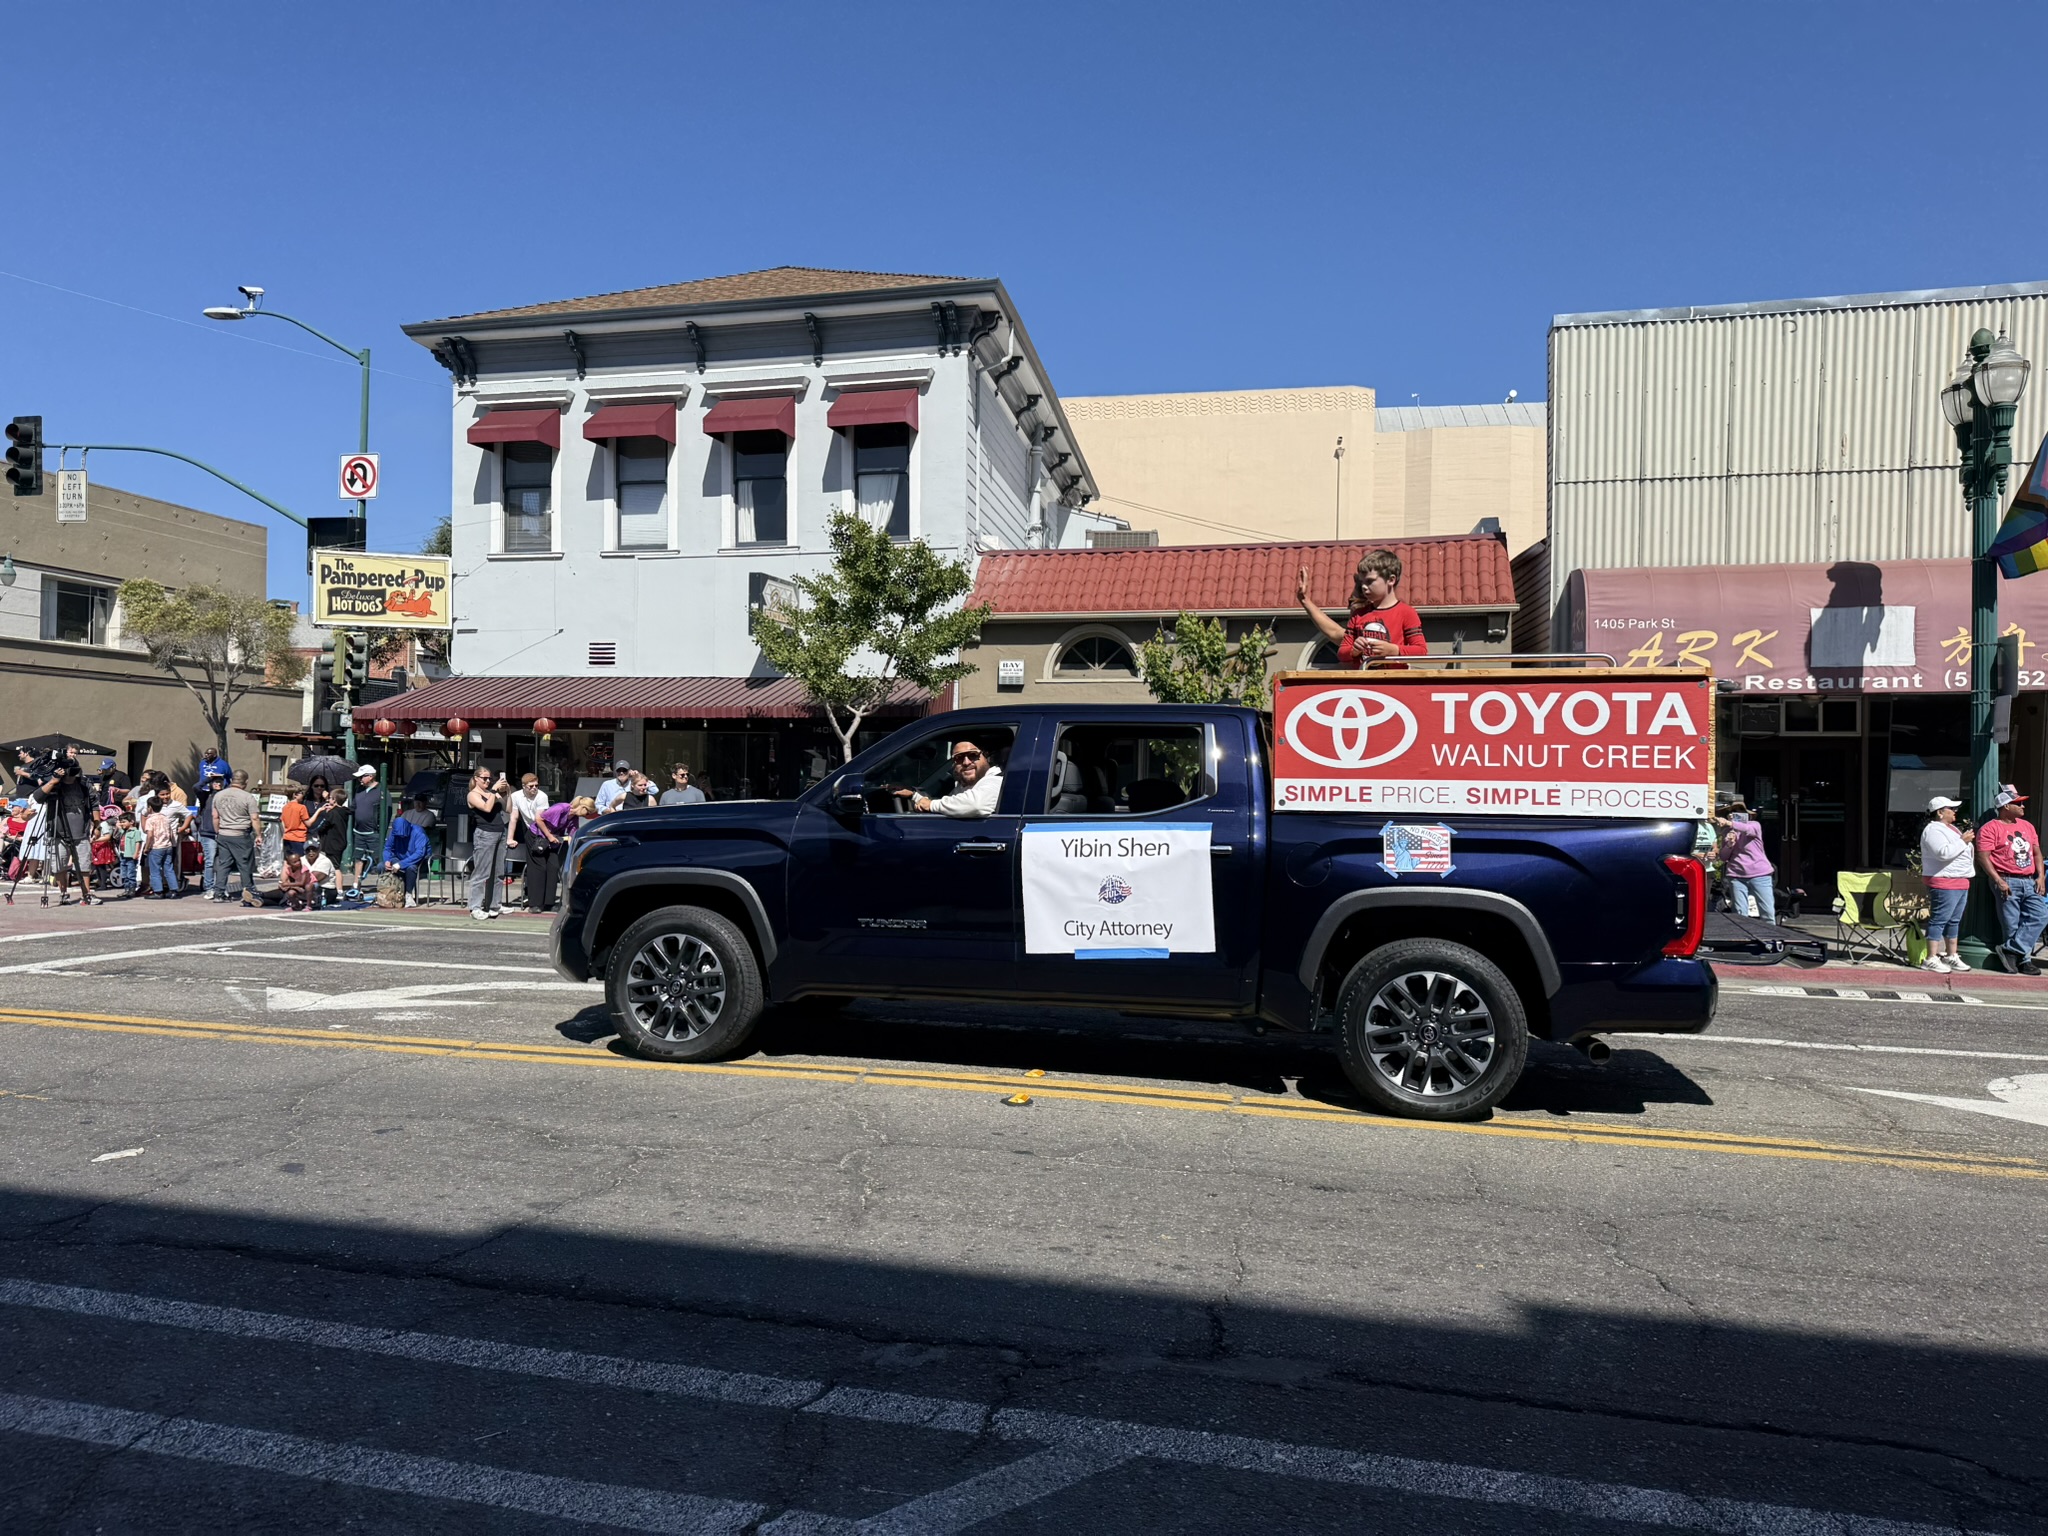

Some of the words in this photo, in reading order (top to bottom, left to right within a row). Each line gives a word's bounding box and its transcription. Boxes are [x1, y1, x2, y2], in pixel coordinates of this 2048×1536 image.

[62, 483, 82, 491] LEFT
[62, 493, 83, 501] TURN
[334, 558, 354, 571] The
[320, 563, 406, 588] Pampered
[414, 568, 446, 592] Pup
[341, 589, 376, 600] Deluxe
[331, 595, 355, 612] HOT
[355, 597, 383, 612] DOGS
[1594, 618, 1625, 629] 1405
[1628, 618, 1658, 629] Park
[1661, 618, 1675, 629] St
[1621, 629, 1779, 668] ARK
[1745, 673, 1923, 690] Restaurant
[1431, 690, 1698, 736] TOYOTA
[1431, 743, 1571, 768] WALNUT
[1582, 744, 1696, 770] CREEK
[1284, 785, 1373, 803] SIMPLE
[1381, 786, 1456, 804] PRICE.
[1466, 787, 1561, 806] SIMPLE
[1571, 788, 1696, 809] PROCESS.
[1409, 826, 1420, 834] NO
[1420, 829, 1443, 844] KINGS
[1061, 838, 1112, 858] Yibin
[1117, 837, 1170, 858] Shen
[1424, 851, 1443, 859] Since
[1425, 861, 1445, 870] 1776
[858, 918, 927, 929] TUNDRA
[1063, 920, 1096, 941] City
[1100, 920, 1174, 940] Attorney
